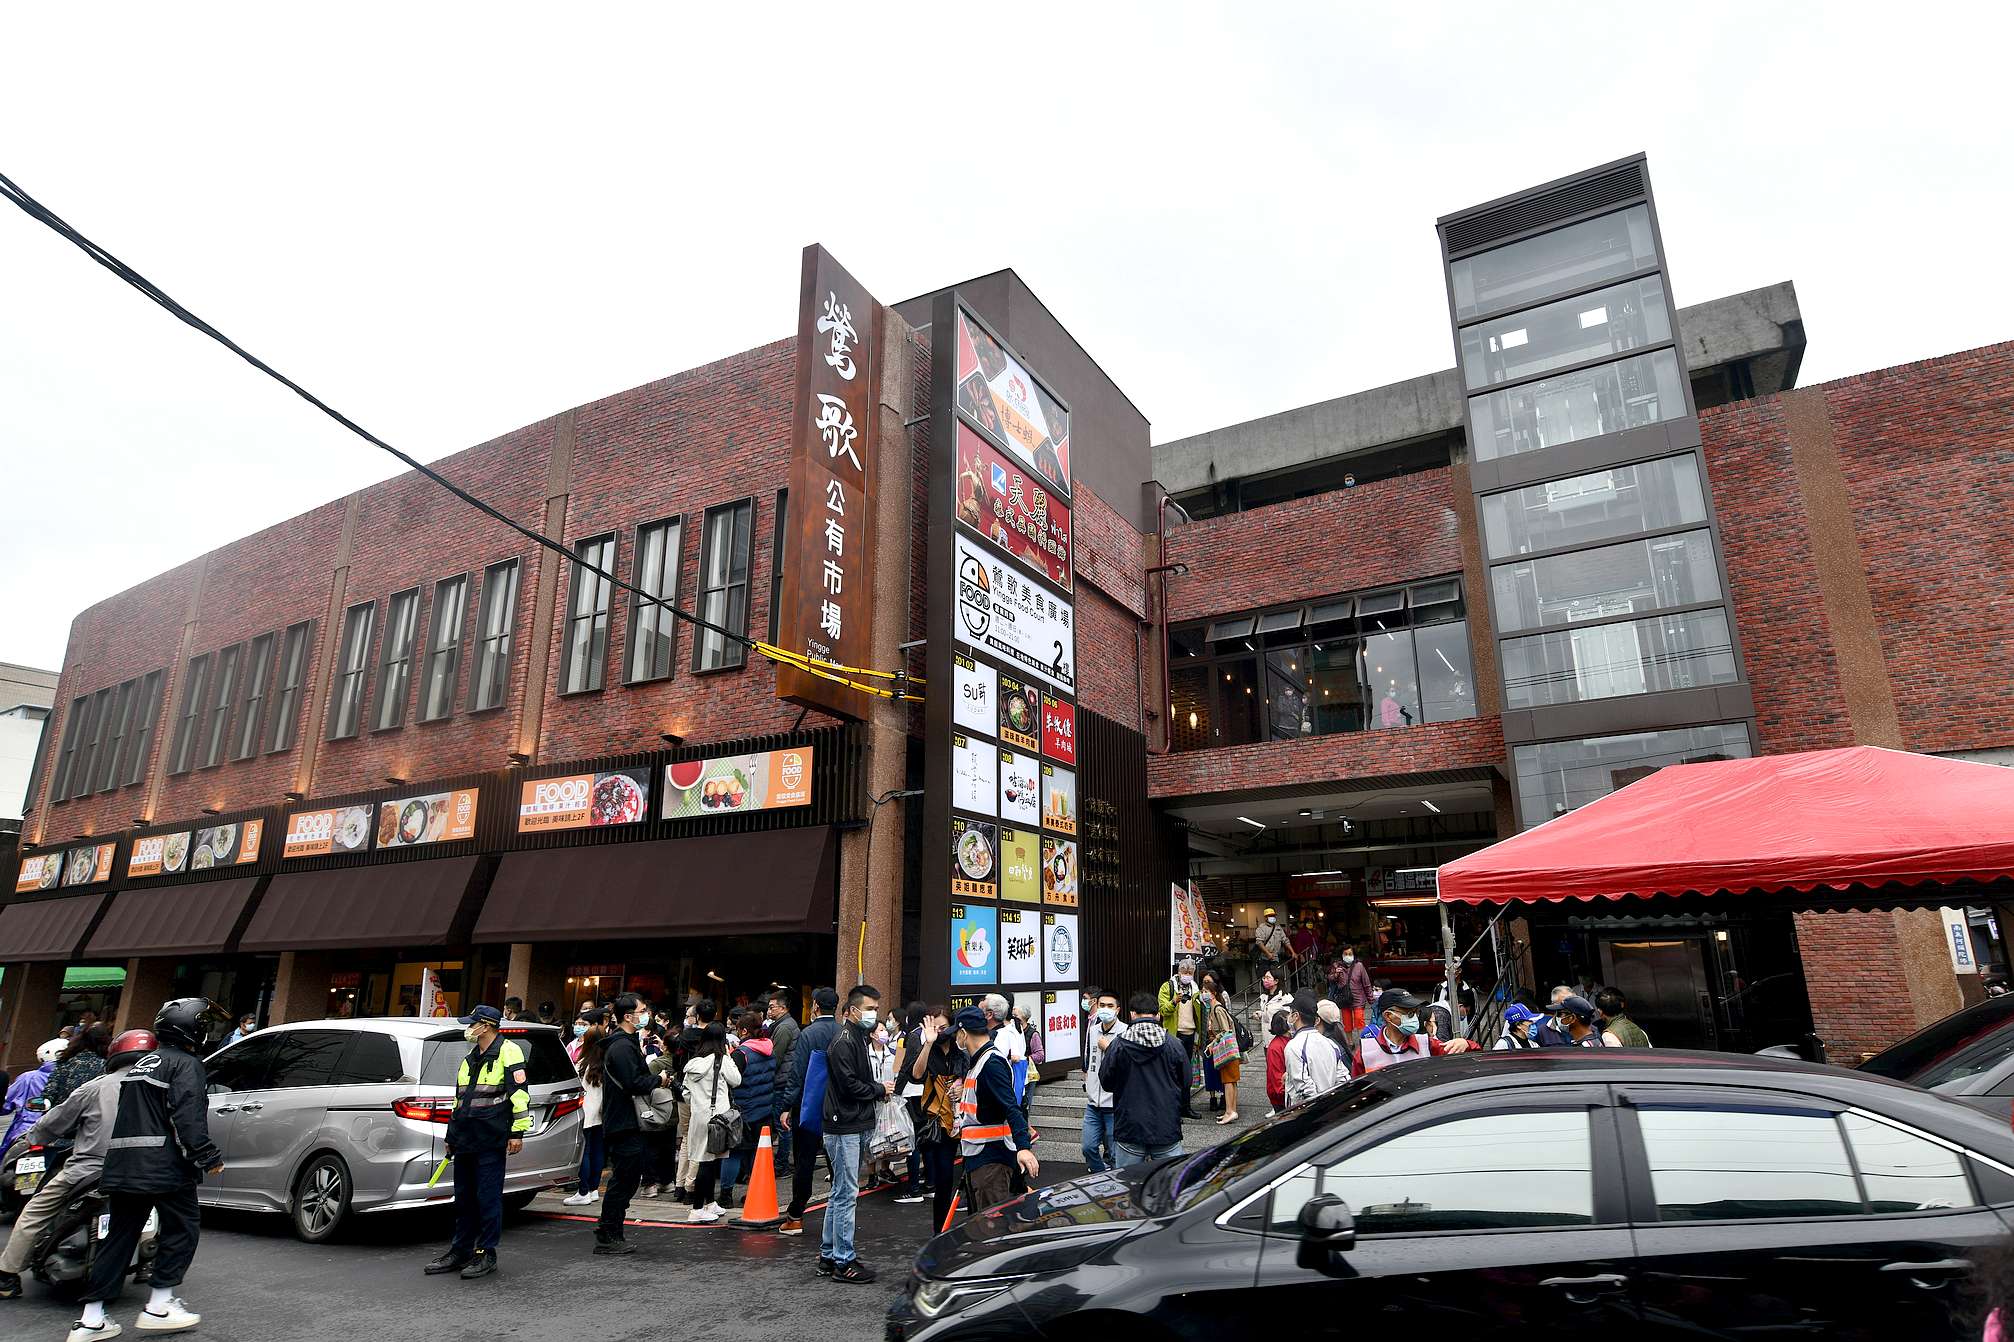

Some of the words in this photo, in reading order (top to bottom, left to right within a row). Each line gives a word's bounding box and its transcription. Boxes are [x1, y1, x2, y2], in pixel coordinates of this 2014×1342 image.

[820, 479, 846, 640] 公有市場
[960, 581, 990, 611] FOOD
[992, 565, 1069, 628] 鶯歌美食廣場
[993, 586, 1013, 605] Yingge
[807, 638, 830, 654] Yingge
[782, 765, 802, 775] FOOD
[535, 780, 589, 804] FOOD
[457, 804, 471, 813] FOOD
[296, 813, 333, 834] FOOD
